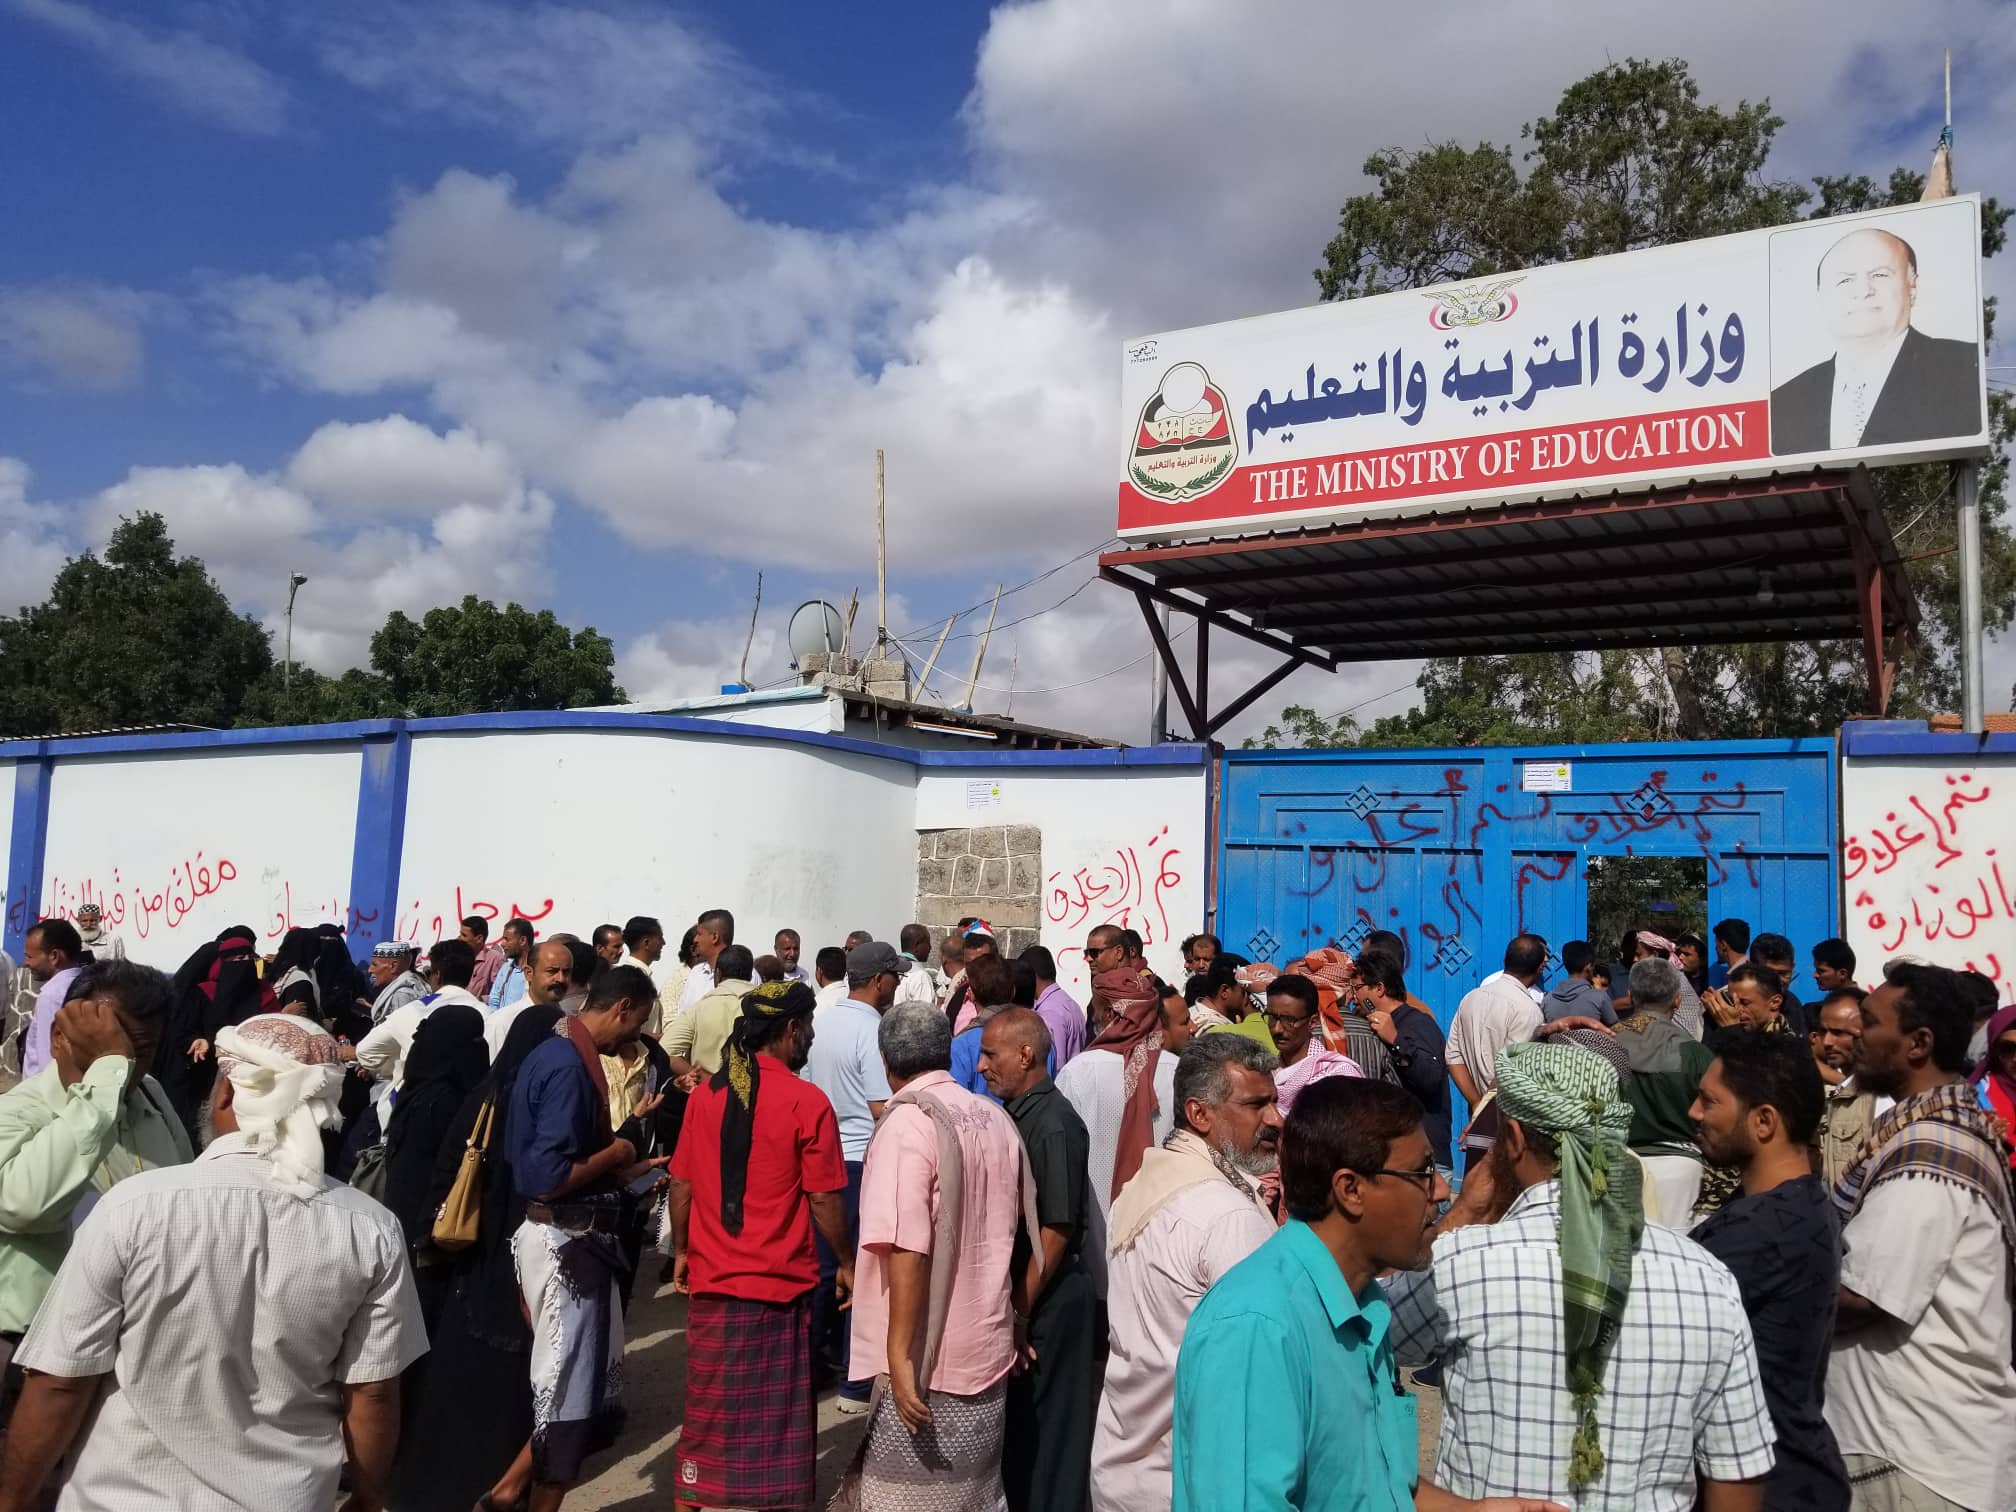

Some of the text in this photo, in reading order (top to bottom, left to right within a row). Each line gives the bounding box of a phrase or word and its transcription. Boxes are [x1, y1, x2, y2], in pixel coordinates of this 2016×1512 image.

[1246, 301, 1746, 457] وزارة التربية والتعليم
[1147, 453, 1217, 473] وزارة التربية والتعليم
[1249, 410, 1747, 504] THE MINISTRY OF EDUCATION
[135, 887, 163, 938] من
[165, 850, 237, 928] مغلق
